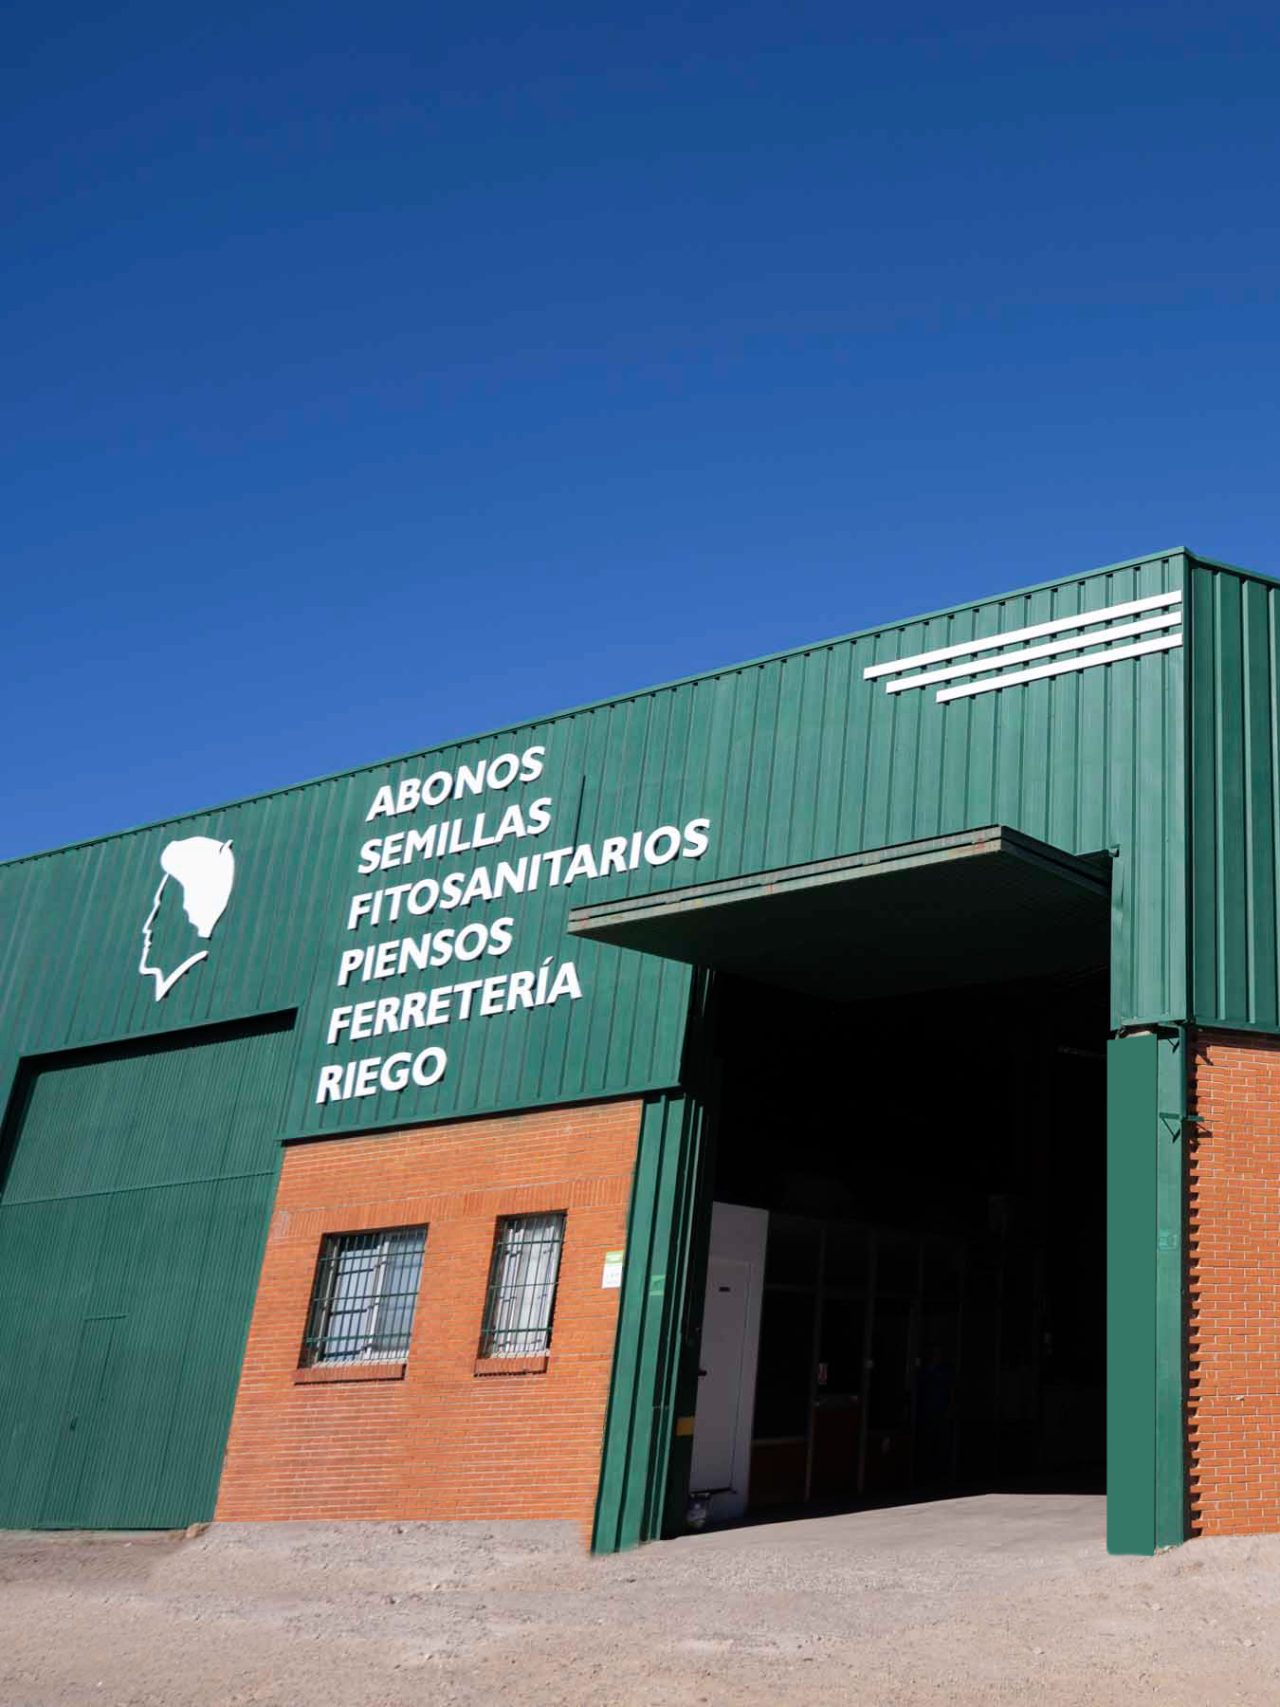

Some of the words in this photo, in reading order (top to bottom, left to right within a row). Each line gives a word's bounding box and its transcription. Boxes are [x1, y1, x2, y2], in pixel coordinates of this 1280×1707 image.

[365, 745, 546, 823] ABONOS
[346, 817, 711, 931] FITOSANITARIOS
[357, 797, 552, 875] SEMILLAS
[336, 916, 515, 987] PIENSOS
[326, 956, 583, 1045] FERRETERÍA
[315, 1046, 448, 1104] RIEGO
